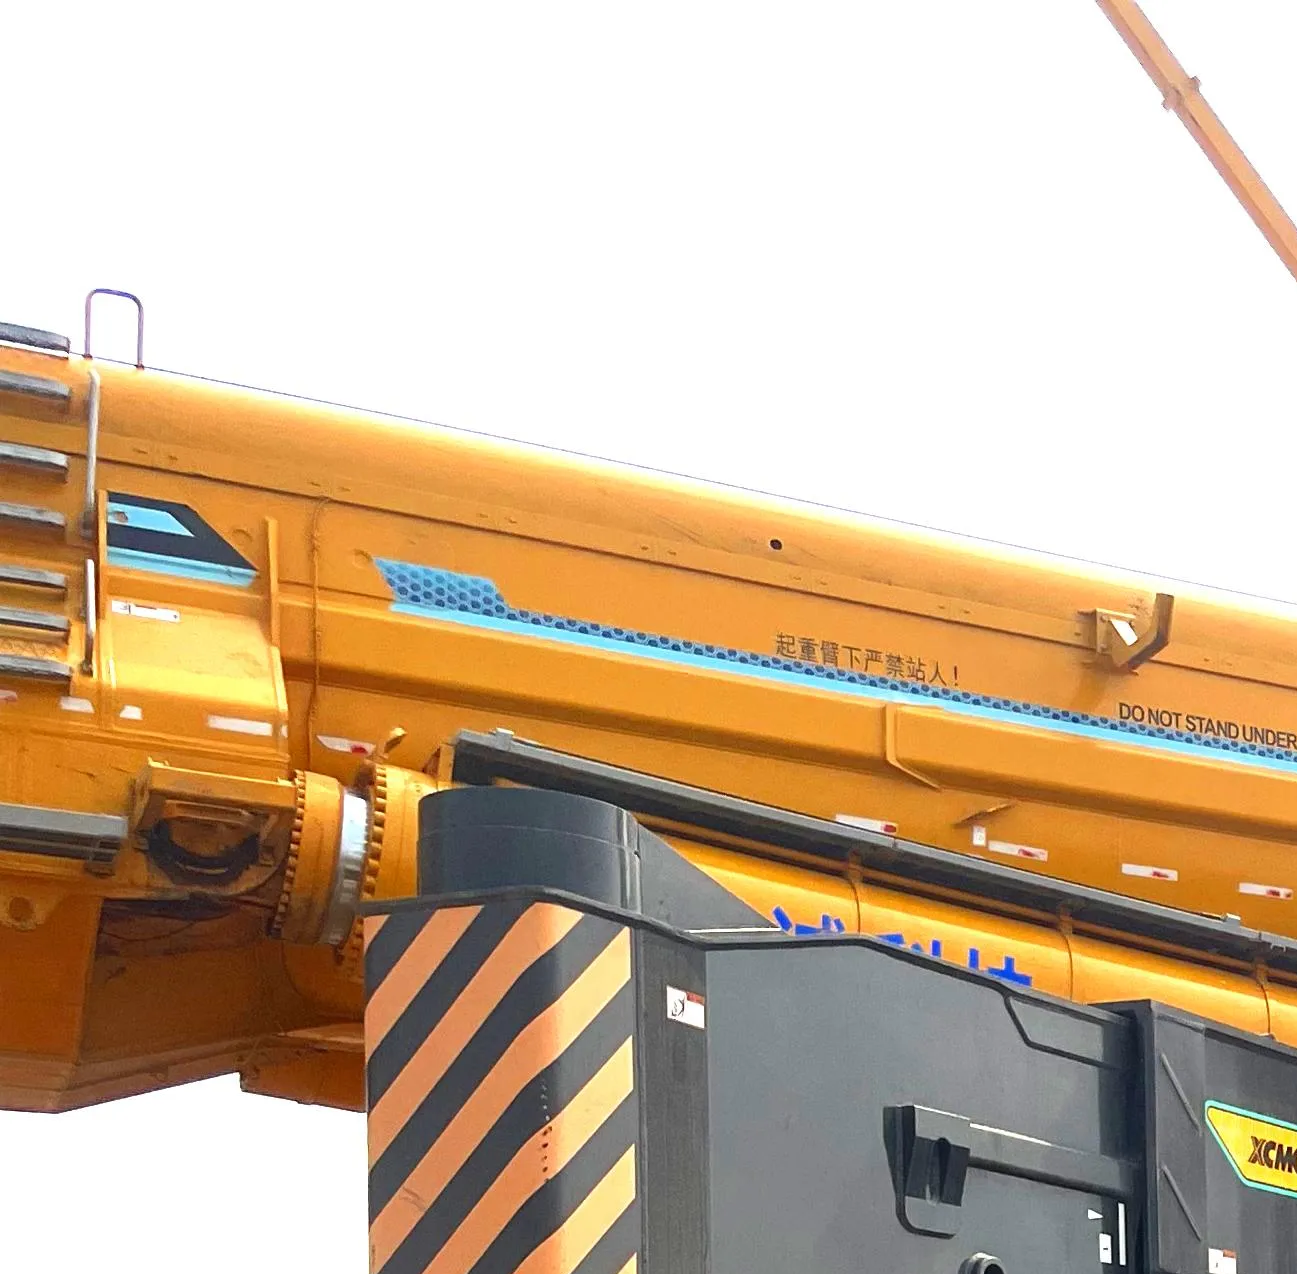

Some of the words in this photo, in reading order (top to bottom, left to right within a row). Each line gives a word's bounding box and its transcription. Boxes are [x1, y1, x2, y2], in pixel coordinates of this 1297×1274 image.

[1119, 702, 1145, 722] DO
[1148, 708, 1182, 729] NOT
[1185, 714, 1240, 740] STAND
